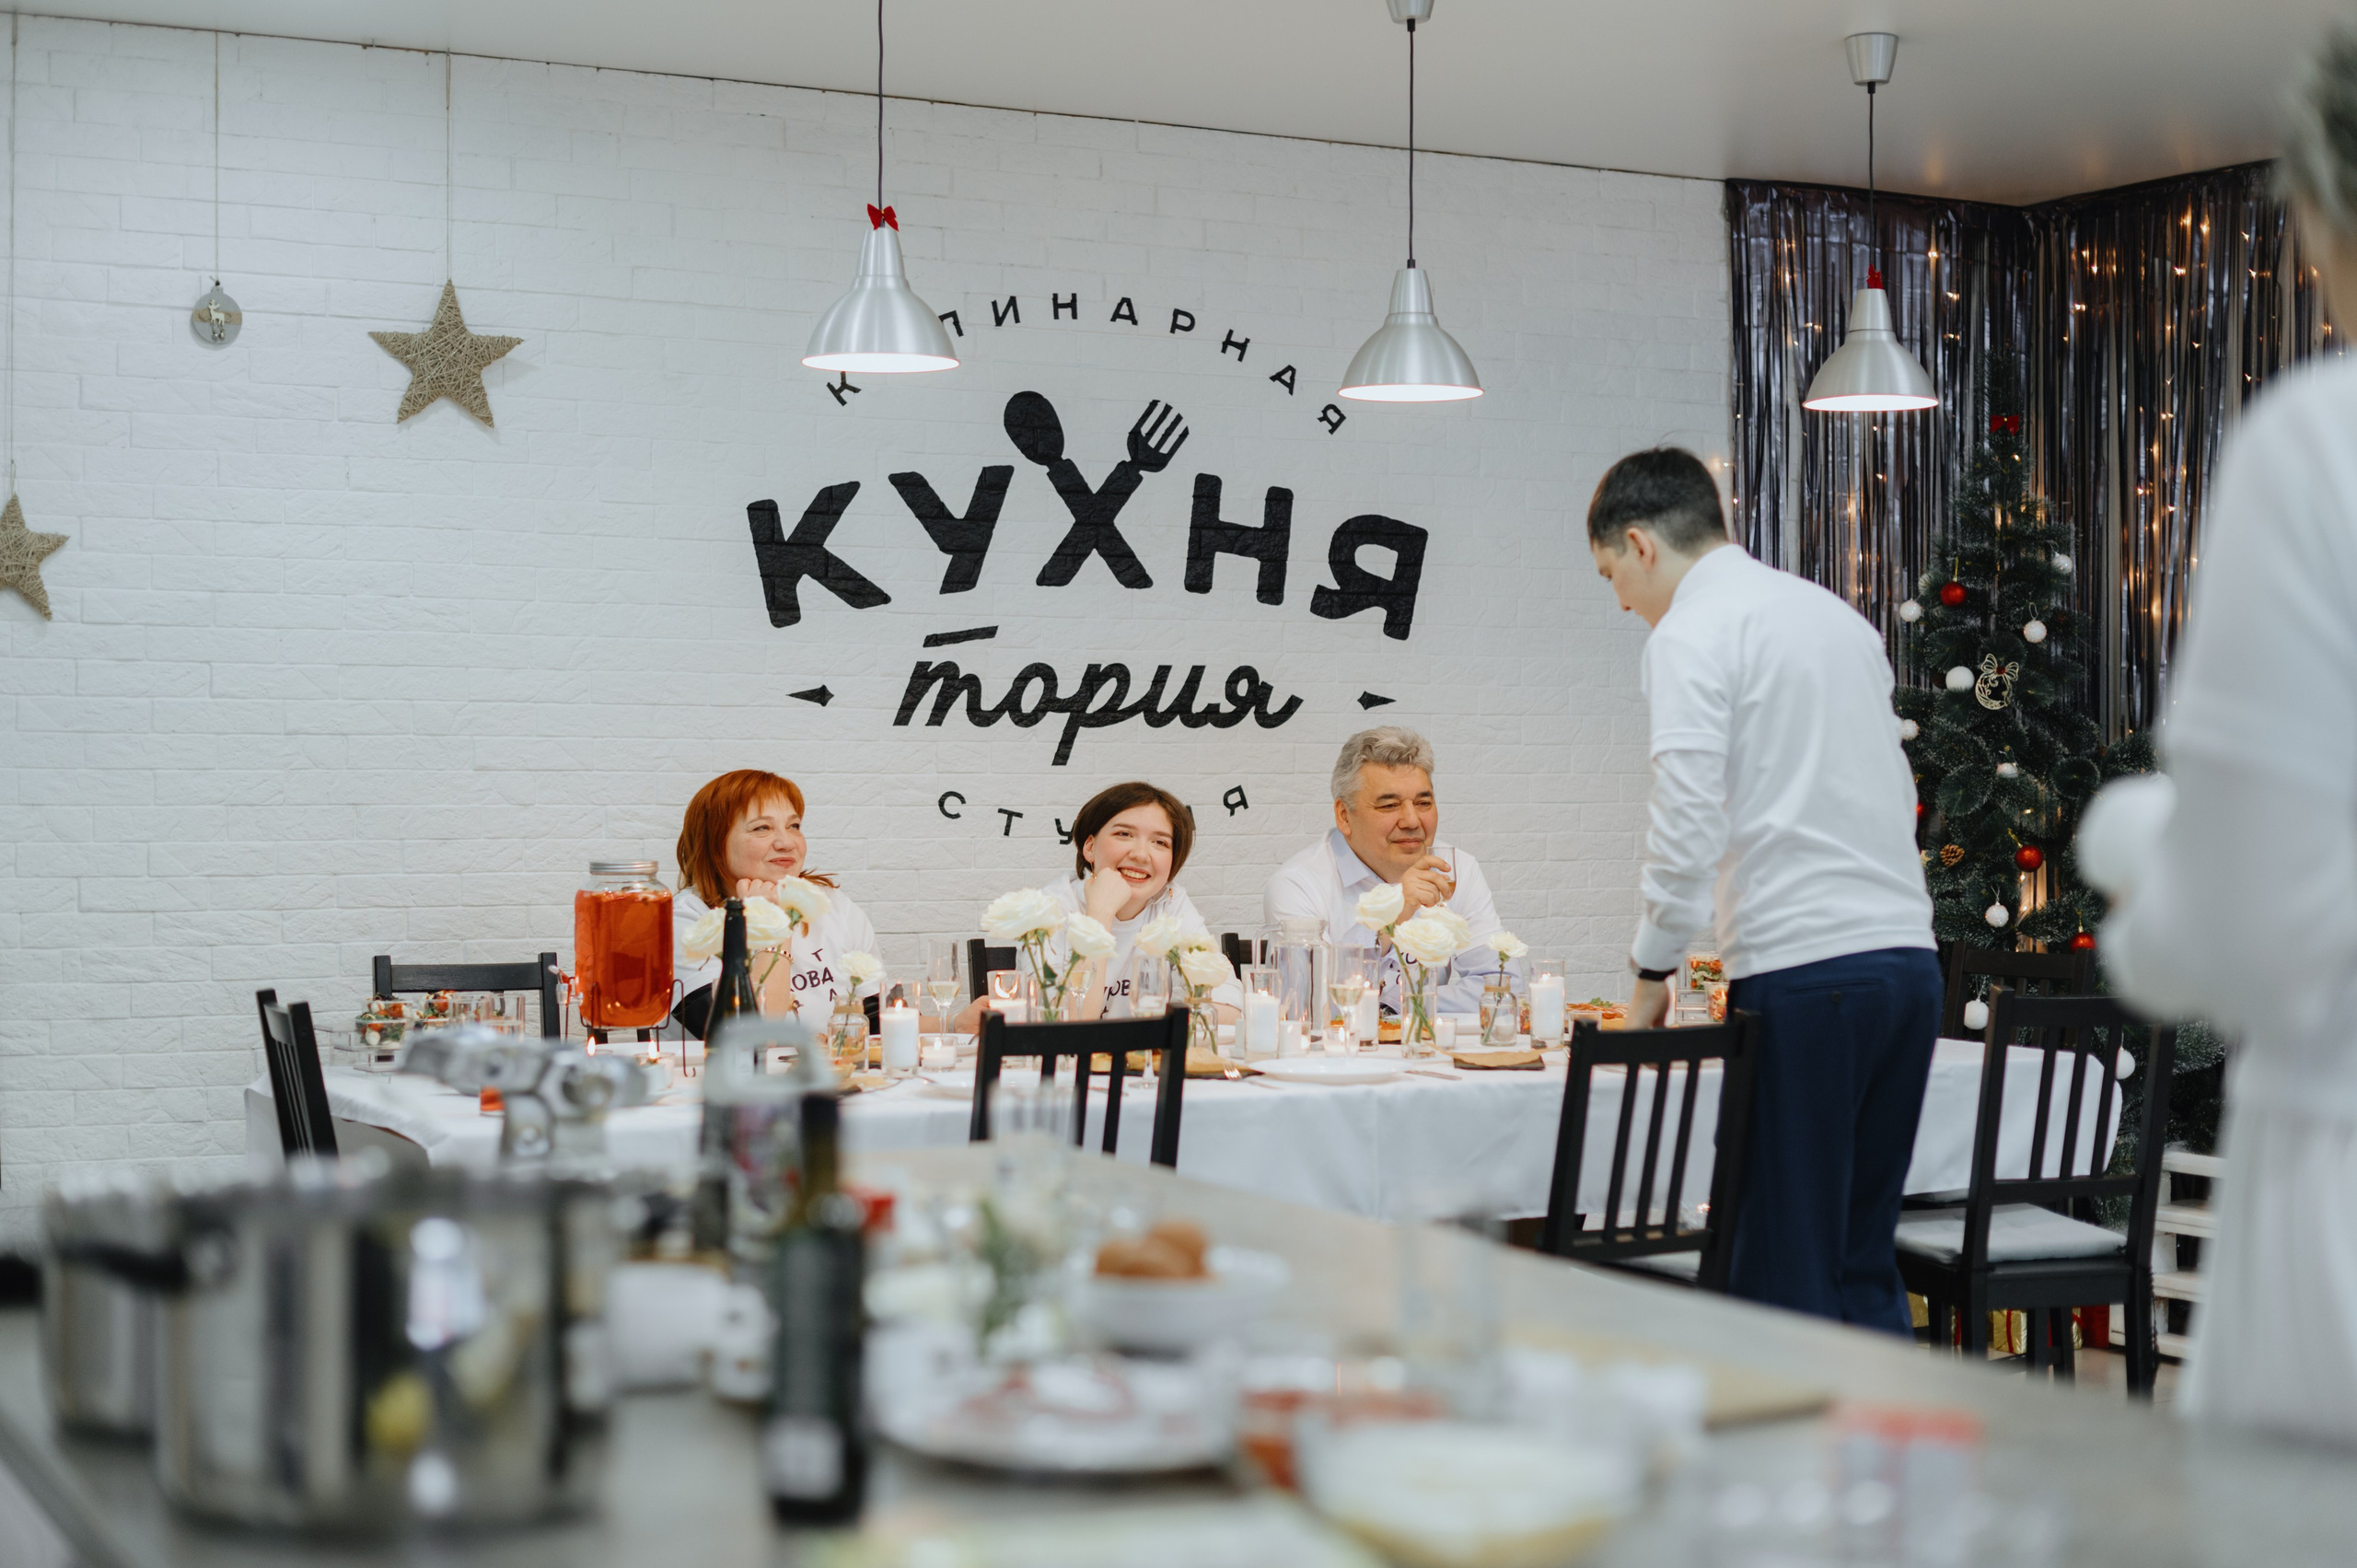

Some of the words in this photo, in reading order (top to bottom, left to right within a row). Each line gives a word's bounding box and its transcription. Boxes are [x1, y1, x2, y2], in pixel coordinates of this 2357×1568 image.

[825, 293, 1348, 436] КЛИНАРНАЯ
[746, 391, 1430, 642] КУХНЯ
[891, 625, 1305, 766] тория
[937, 784, 1250, 845] СТУЯ
